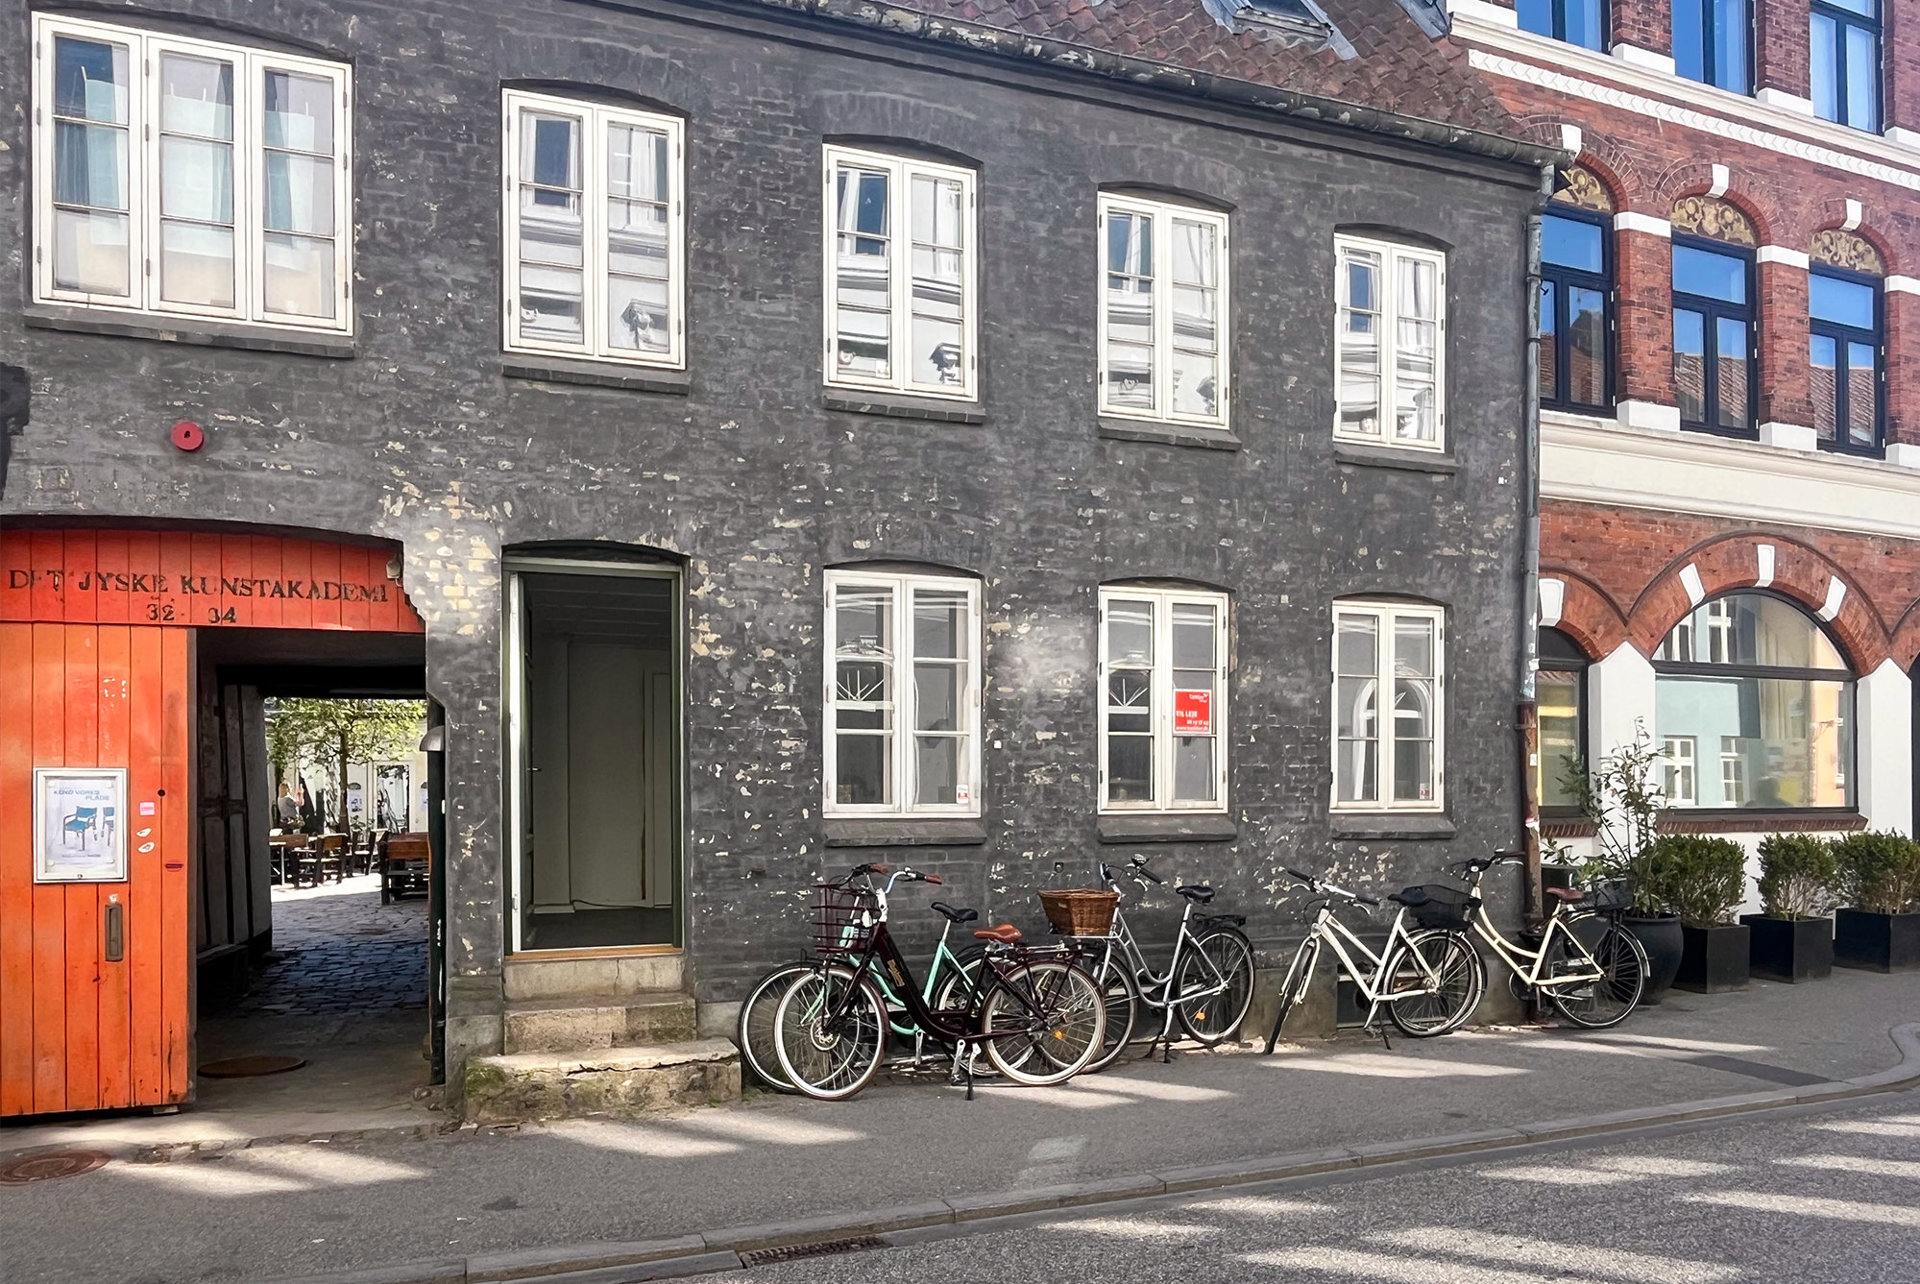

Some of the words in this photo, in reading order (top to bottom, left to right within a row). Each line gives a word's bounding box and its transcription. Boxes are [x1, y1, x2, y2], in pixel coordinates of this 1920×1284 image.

[78, 571, 168, 593] JYSKE
[180, 574, 389, 602] KUNSTAKADEMI
[146, 603, 175, 621] 32
